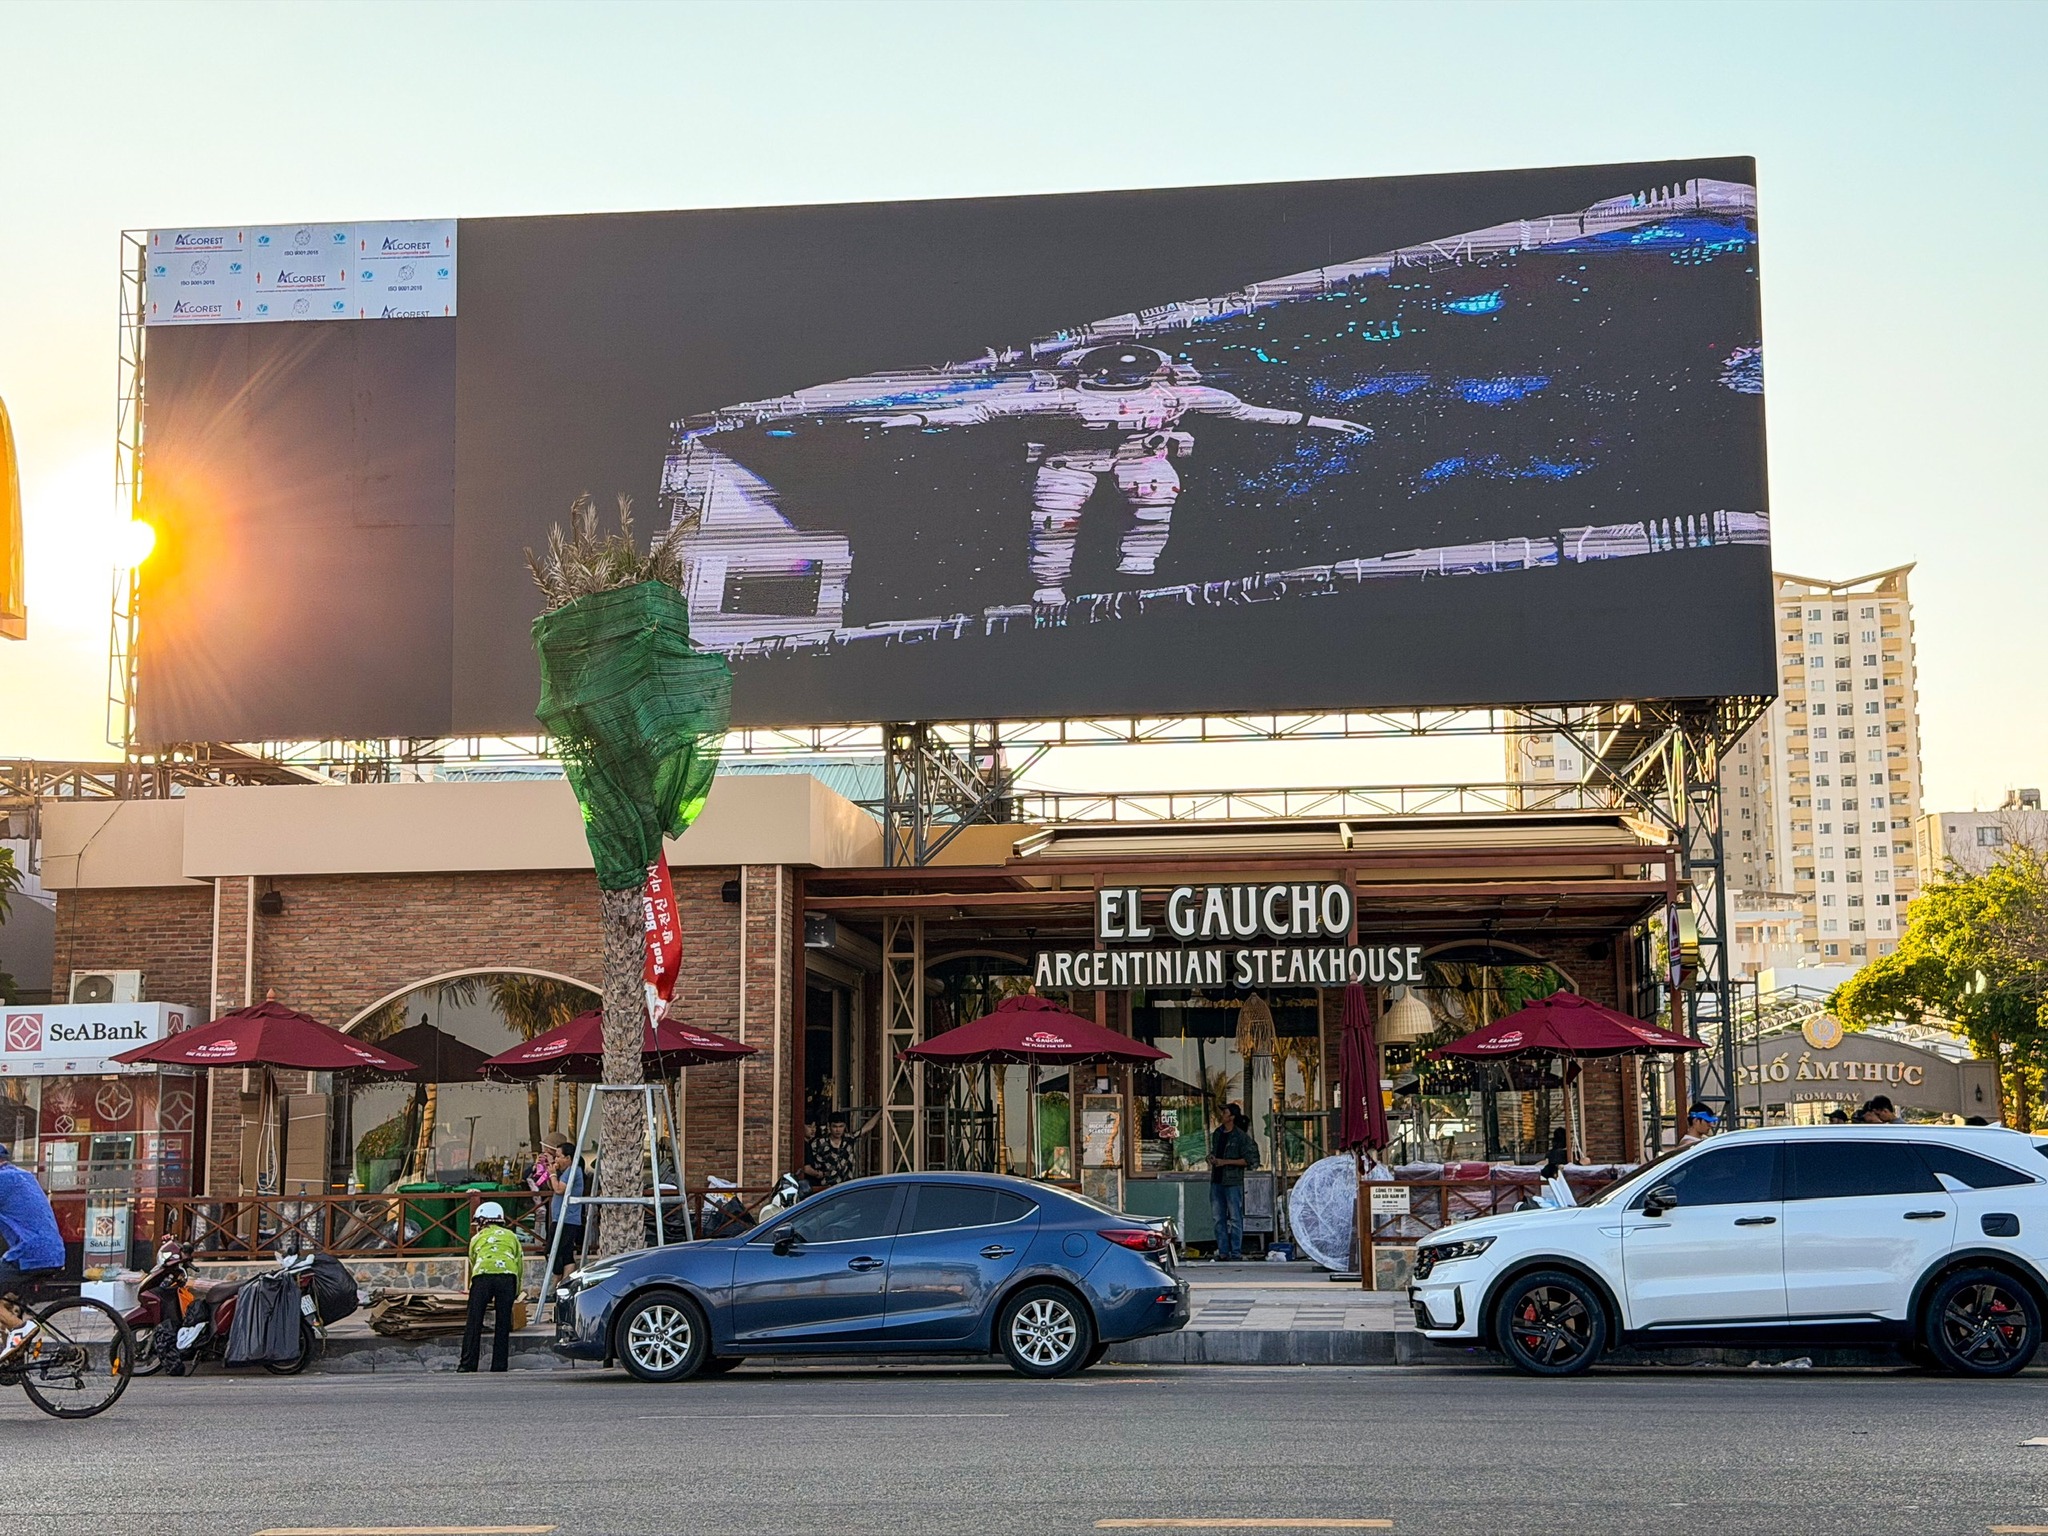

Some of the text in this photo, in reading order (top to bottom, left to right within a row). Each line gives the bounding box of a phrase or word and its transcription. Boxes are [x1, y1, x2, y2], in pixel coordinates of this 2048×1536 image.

[175, 234, 224, 245] ALCOREST
[382, 237, 431, 250] ALCOREST
[277, 270, 326, 283] ALCOREST
[173, 300, 222, 313] ALCOREST
[646, 861, 662, 893] 마사
[643, 896, 657, 931] Body
[1100, 884, 1350, 938] EL GAUCHO
[650, 942, 664, 975] Foot
[1035, 947, 1423, 987] ARGENTINIAN STEAKHOUSE
[50, 1021, 148, 1041] SeABank
[1843, 1060, 1923, 1088] THỰC
[1795, 1091, 1861, 1102] ROMA BAY
